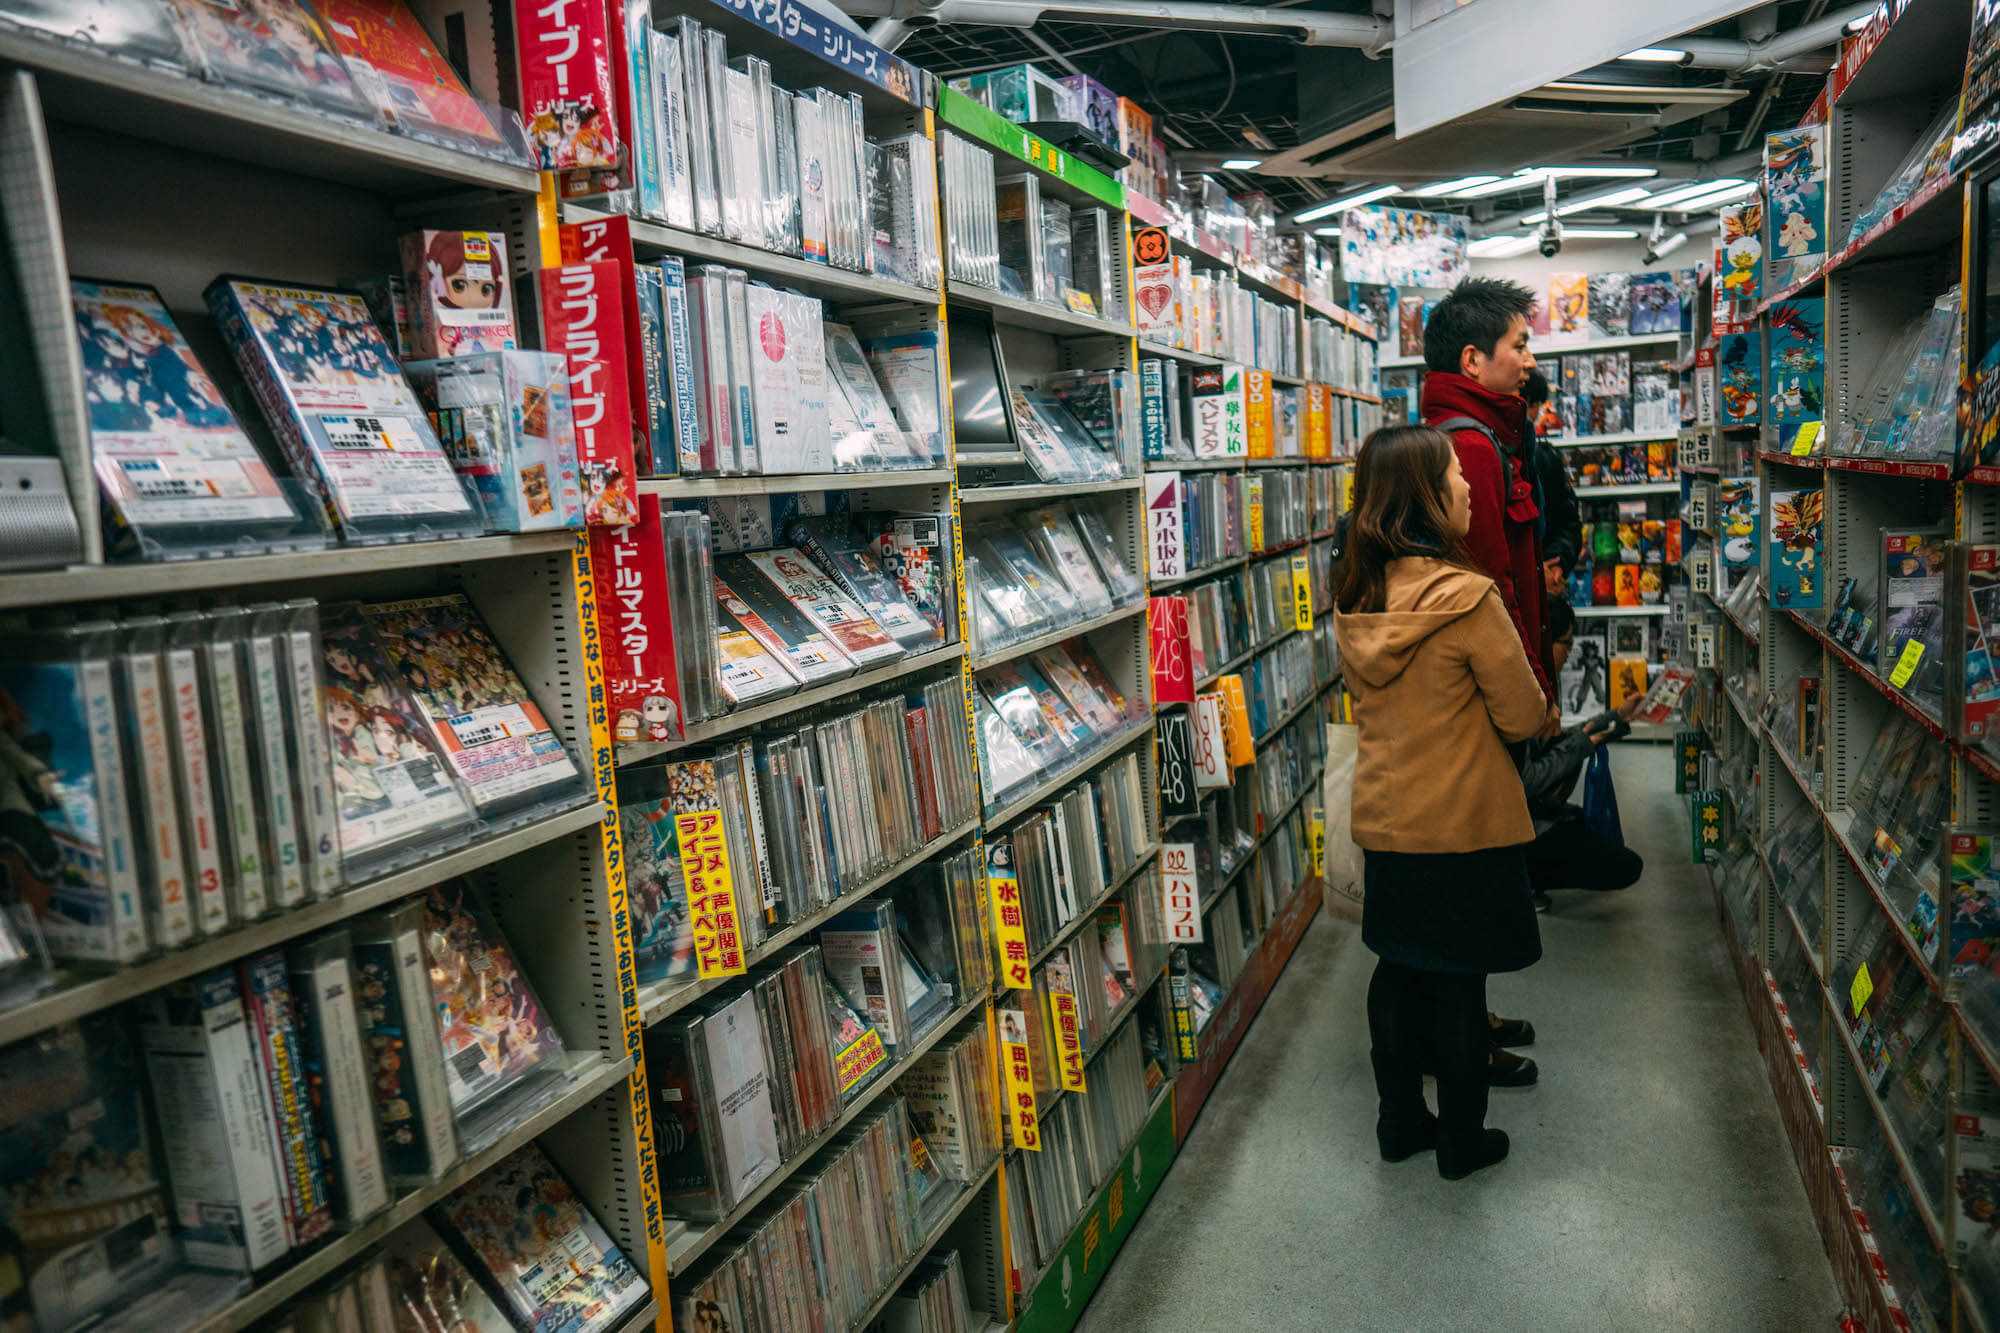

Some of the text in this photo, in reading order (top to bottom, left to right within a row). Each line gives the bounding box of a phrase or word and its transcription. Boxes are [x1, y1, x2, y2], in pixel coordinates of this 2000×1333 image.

[823, 26, 879, 80] シリーズ
[559, 265, 606, 458] ラブライブ！
[1249, 373, 1264, 403] DVD
[1311, 387, 1324, 412] DVD
[1155, 511, 1178, 577] 乃木坂46
[1696, 563, 1708, 590] は行
[1150, 597, 1190, 639] AKB
[1153, 639, 1185, 683] 48
[611, 677, 665, 694] シリーズ
[1156, 716, 1187, 762] HKT
[1194, 736, 1216, 776] 48
[1161, 761, 1186, 804] 48
[318, 834, 332, 854] 6
[1702, 805, 1720, 843] 本体
[280, 843, 296, 865] 5
[163, 879, 181, 904] 2
[200, 869, 219, 891] 3
[699, 813, 741, 970] アニメ・声優関連
[1170, 880, 1194, 938] ハロプロ
[998, 881, 1028, 985] 水樹 奈々
[1056, 995, 1083, 1087] 声優ライブ
[1011, 1045, 1037, 1147] 田村 ゆかり
